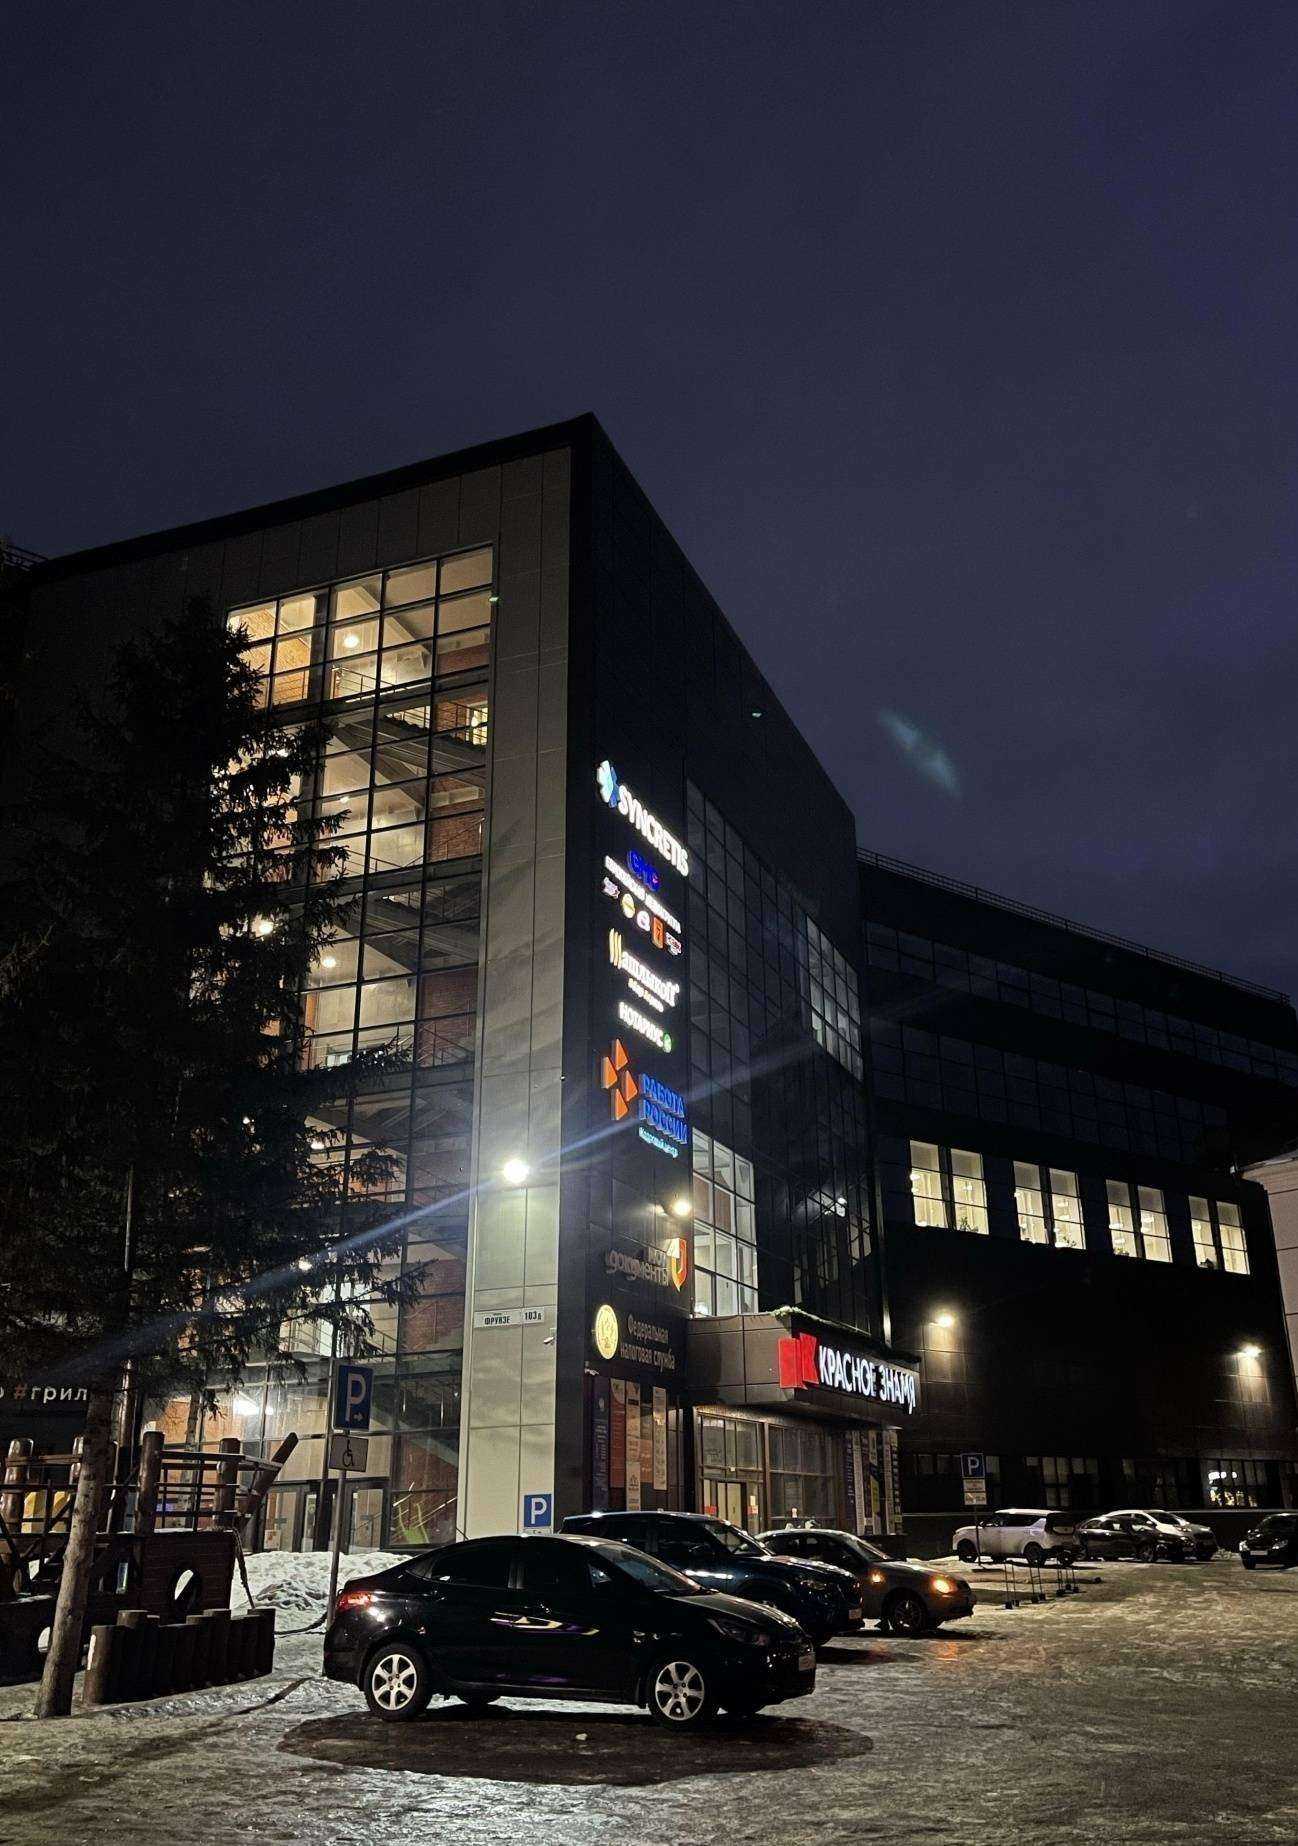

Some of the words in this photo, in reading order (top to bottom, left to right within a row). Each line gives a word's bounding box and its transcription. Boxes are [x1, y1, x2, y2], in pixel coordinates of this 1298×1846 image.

[641, 1073, 685, 1118] РАБОТА
[640, 1099, 688, 1145] РОССИИ
[484, 1315, 511, 1326] ФРУНЗЕ
[347, 1372, 366, 1422] P
[818, 1344, 876, 1397] КРАСНОЕ
[878, 1364, 917, 1415] ЗНАМЯ
[967, 1456, 979, 1476] P
[530, 1497, 547, 1525] P
